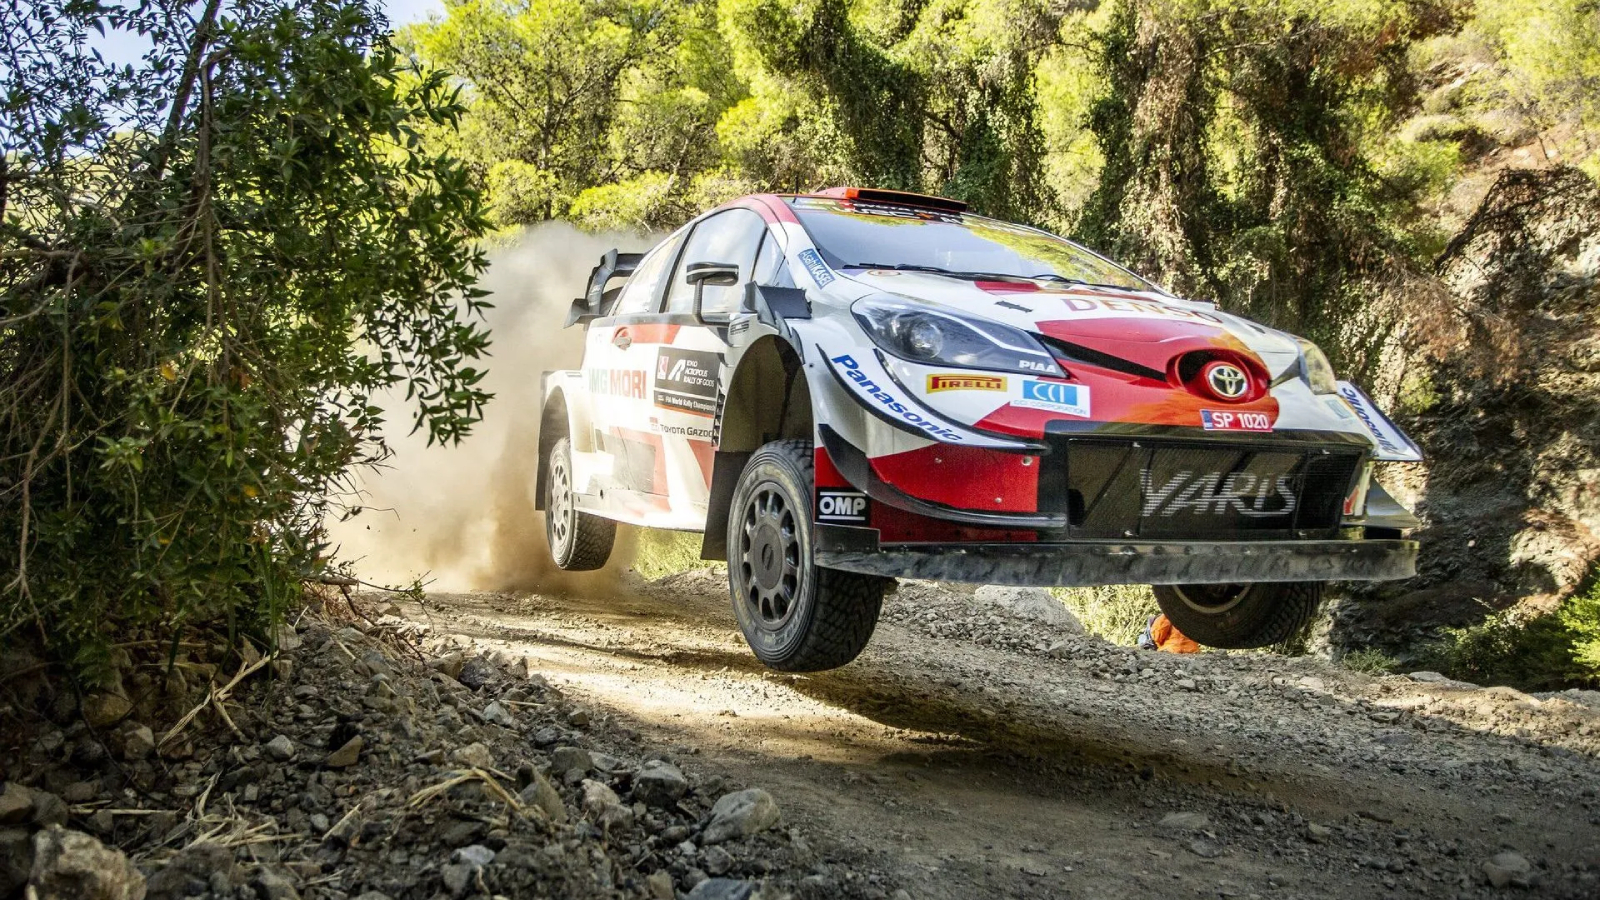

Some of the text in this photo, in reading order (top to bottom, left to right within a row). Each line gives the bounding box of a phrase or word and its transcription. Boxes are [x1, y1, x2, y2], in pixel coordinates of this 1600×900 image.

[1060, 298, 1223, 324] DENSO
[684, 367, 708, 377] ACROPOLIS
[1018, 359, 1057, 374] PIAA
[610, 368, 647, 400] MORI
[702, 378, 715, 387] GODS
[931, 376, 1001, 390] PIRELLI
[683, 399, 693, 409] Rally
[832, 354, 964, 441] Panasonic
[1029, 401, 1087, 415] CORPORATION
[1211, 412, 1270, 430] SP 1020
[660, 423, 685, 435] TOYOTA
[1140, 469, 1296, 517] YARIS
[819, 497, 866, 515] OMP
